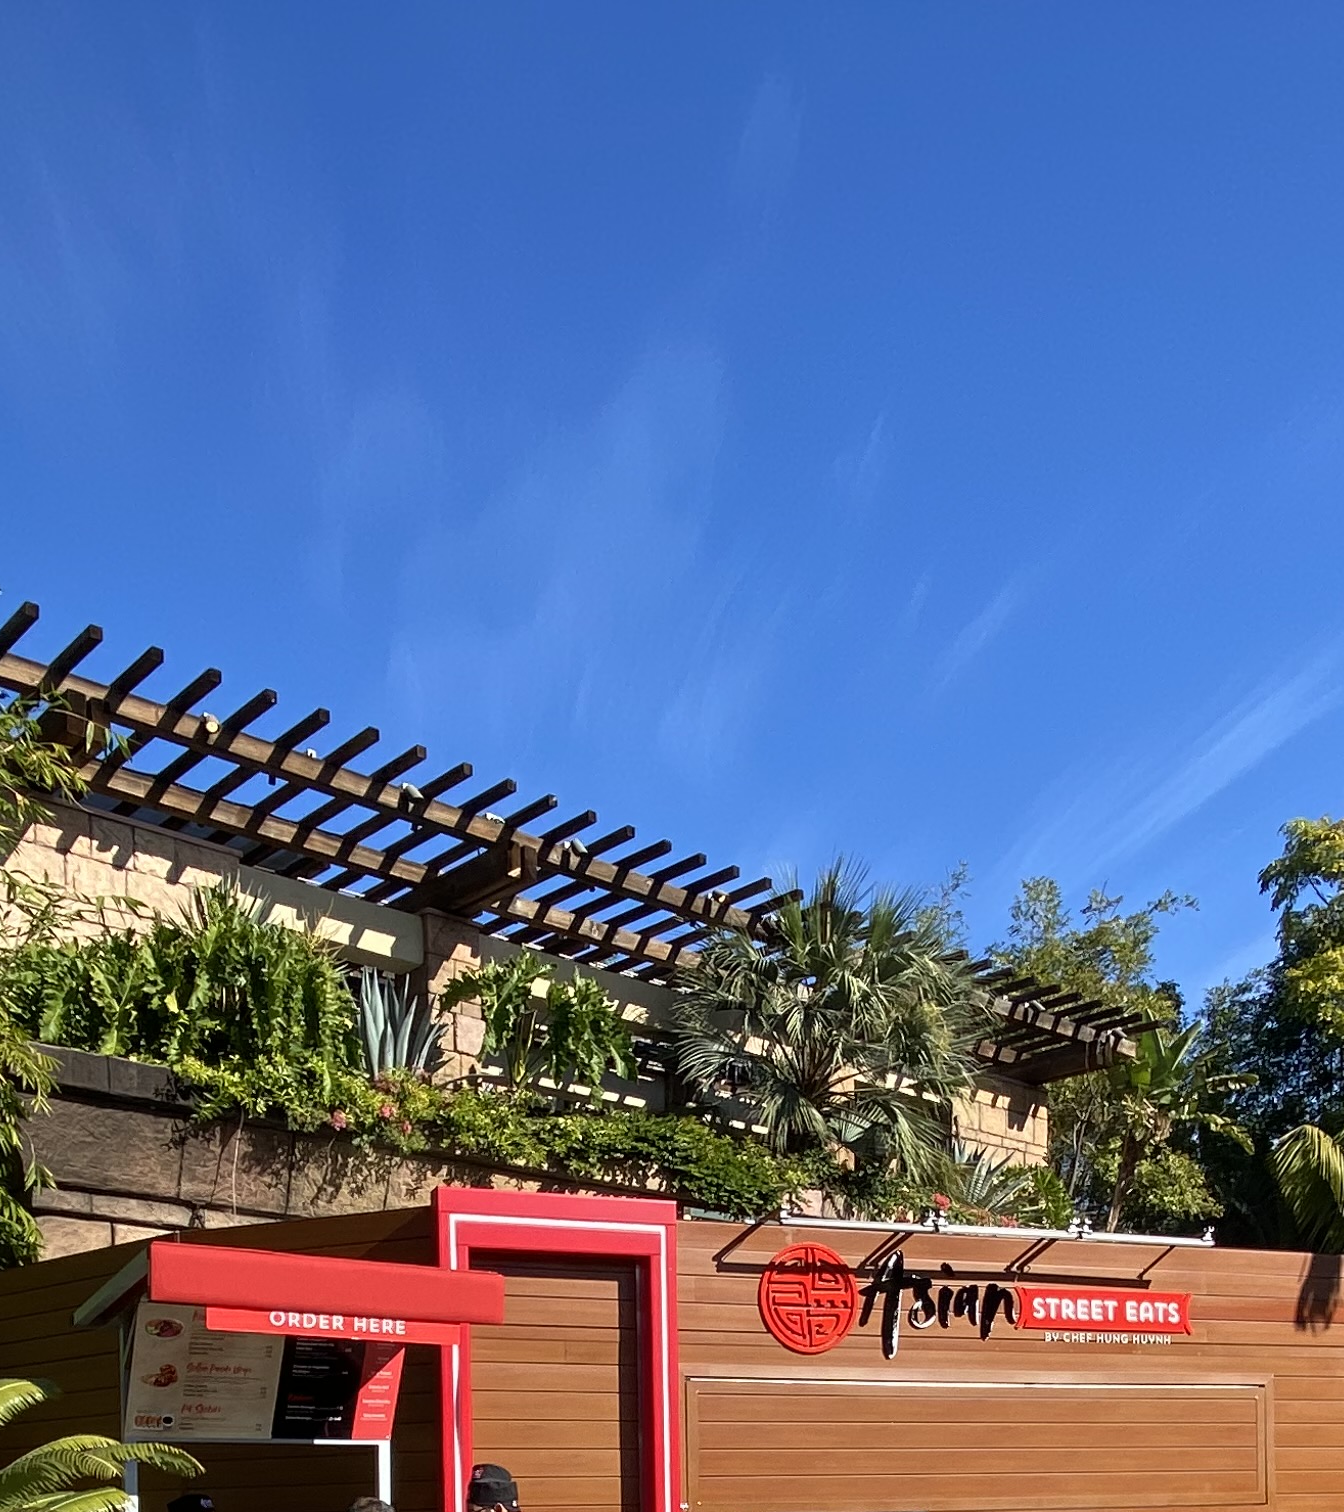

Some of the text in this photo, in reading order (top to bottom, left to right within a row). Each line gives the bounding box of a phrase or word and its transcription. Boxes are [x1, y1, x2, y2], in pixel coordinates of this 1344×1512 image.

[858, 1250, 1181, 1360] Asian STREET EATS
[269, 1311, 406, 1335] ORDER HERE
[1044, 1332, 1172, 1345] BY CHEF HUNG HUYNH
